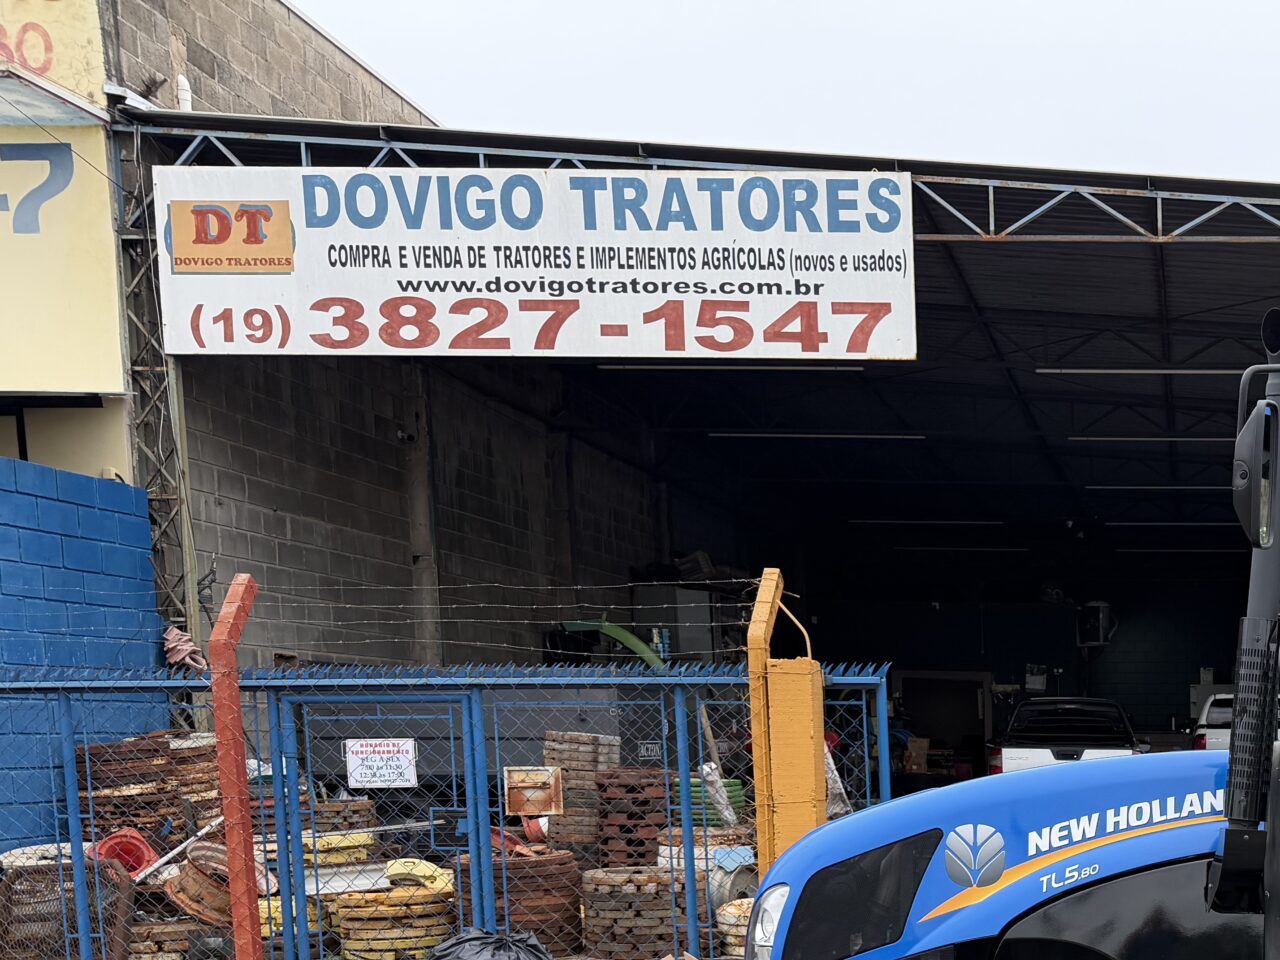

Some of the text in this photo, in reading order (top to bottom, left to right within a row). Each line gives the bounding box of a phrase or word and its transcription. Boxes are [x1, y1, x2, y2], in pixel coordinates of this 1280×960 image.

[0, 143, 74, 234] 7
[302, 174, 903, 235] DOVIGO TRATORES
[191, 204, 273, 245] DT
[174, 257, 292, 267] DOVIGO TRATORES
[328, 239, 907, 279] COMPRA E VENDA DE TRATORES E IMPLEMENTOS AGRÍCOLAS (novos e usados)
[396, 275, 825, 297] www.dovigotratores.com.br
[190, 296, 892, 354] (19) 3827-1547
[1027, 788, 1225, 857] NEW HOLLAN
[1040, 864, 1099, 893] TL5.80
